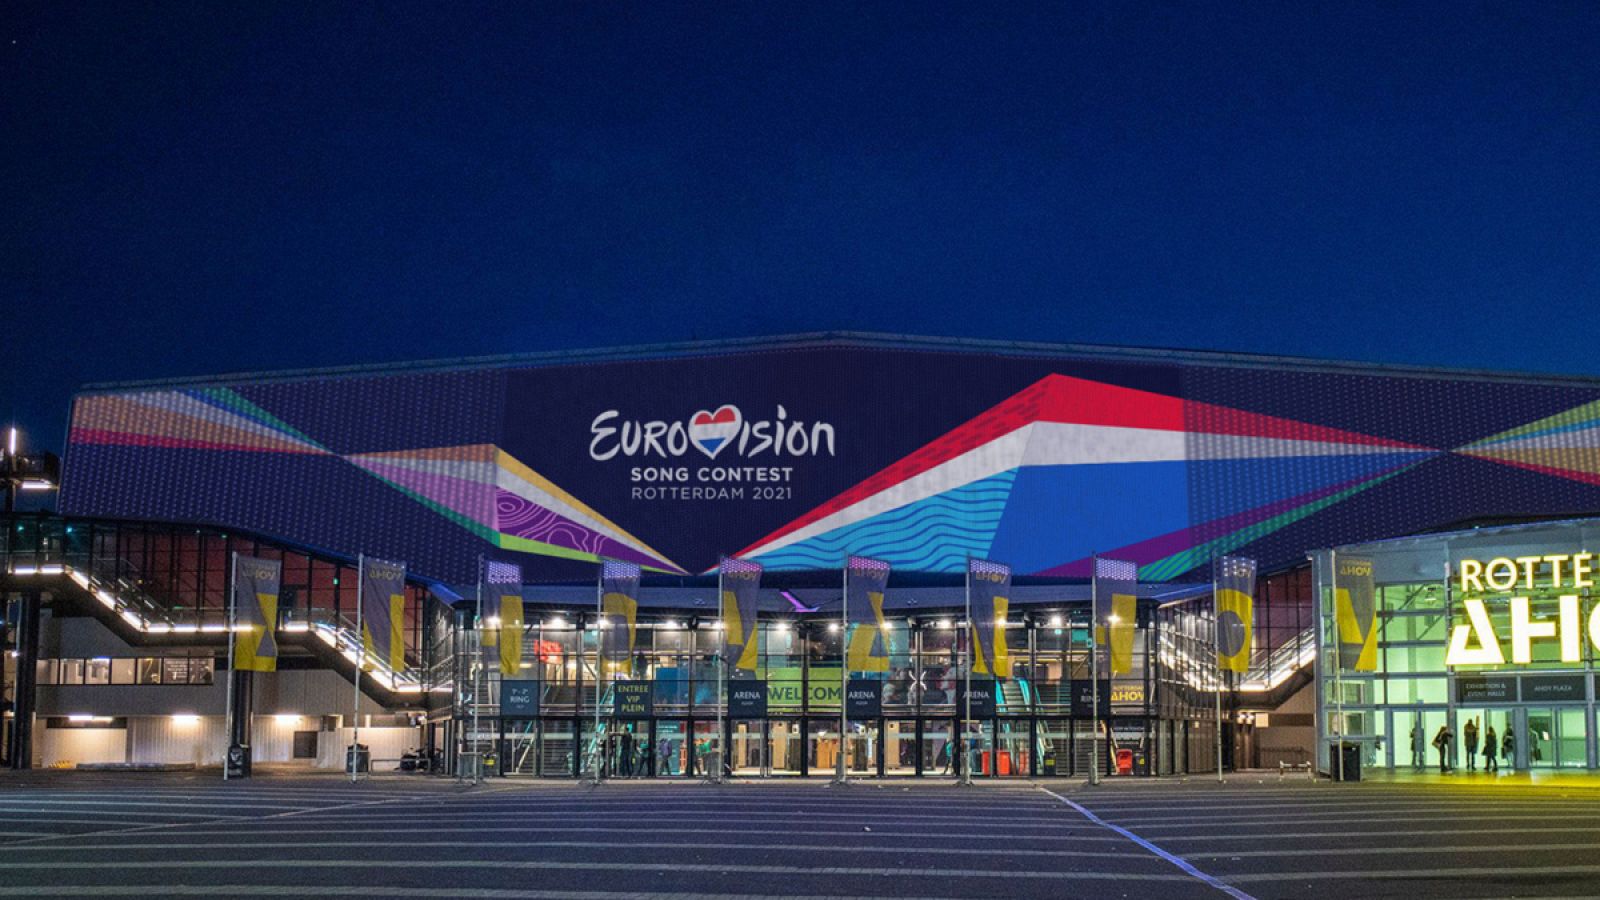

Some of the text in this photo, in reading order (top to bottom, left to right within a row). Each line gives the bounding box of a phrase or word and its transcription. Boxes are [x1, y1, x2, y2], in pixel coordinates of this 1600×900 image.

[631, 467, 793, 482] SONG CONTEST
[631, 487, 792, 500] ROTTERDAM 2021
[1460, 553, 1600, 593] ROTTE
[1445, 594, 1600, 665] AH
[618, 685, 649, 693] ENTREE
[768, 686, 842, 701] WELCOM
[626, 695, 640, 703] VIP
[734, 691, 760, 700] ARENA
[849, 691, 875, 700] ARENA
[621, 704, 645, 712] PLEIN
